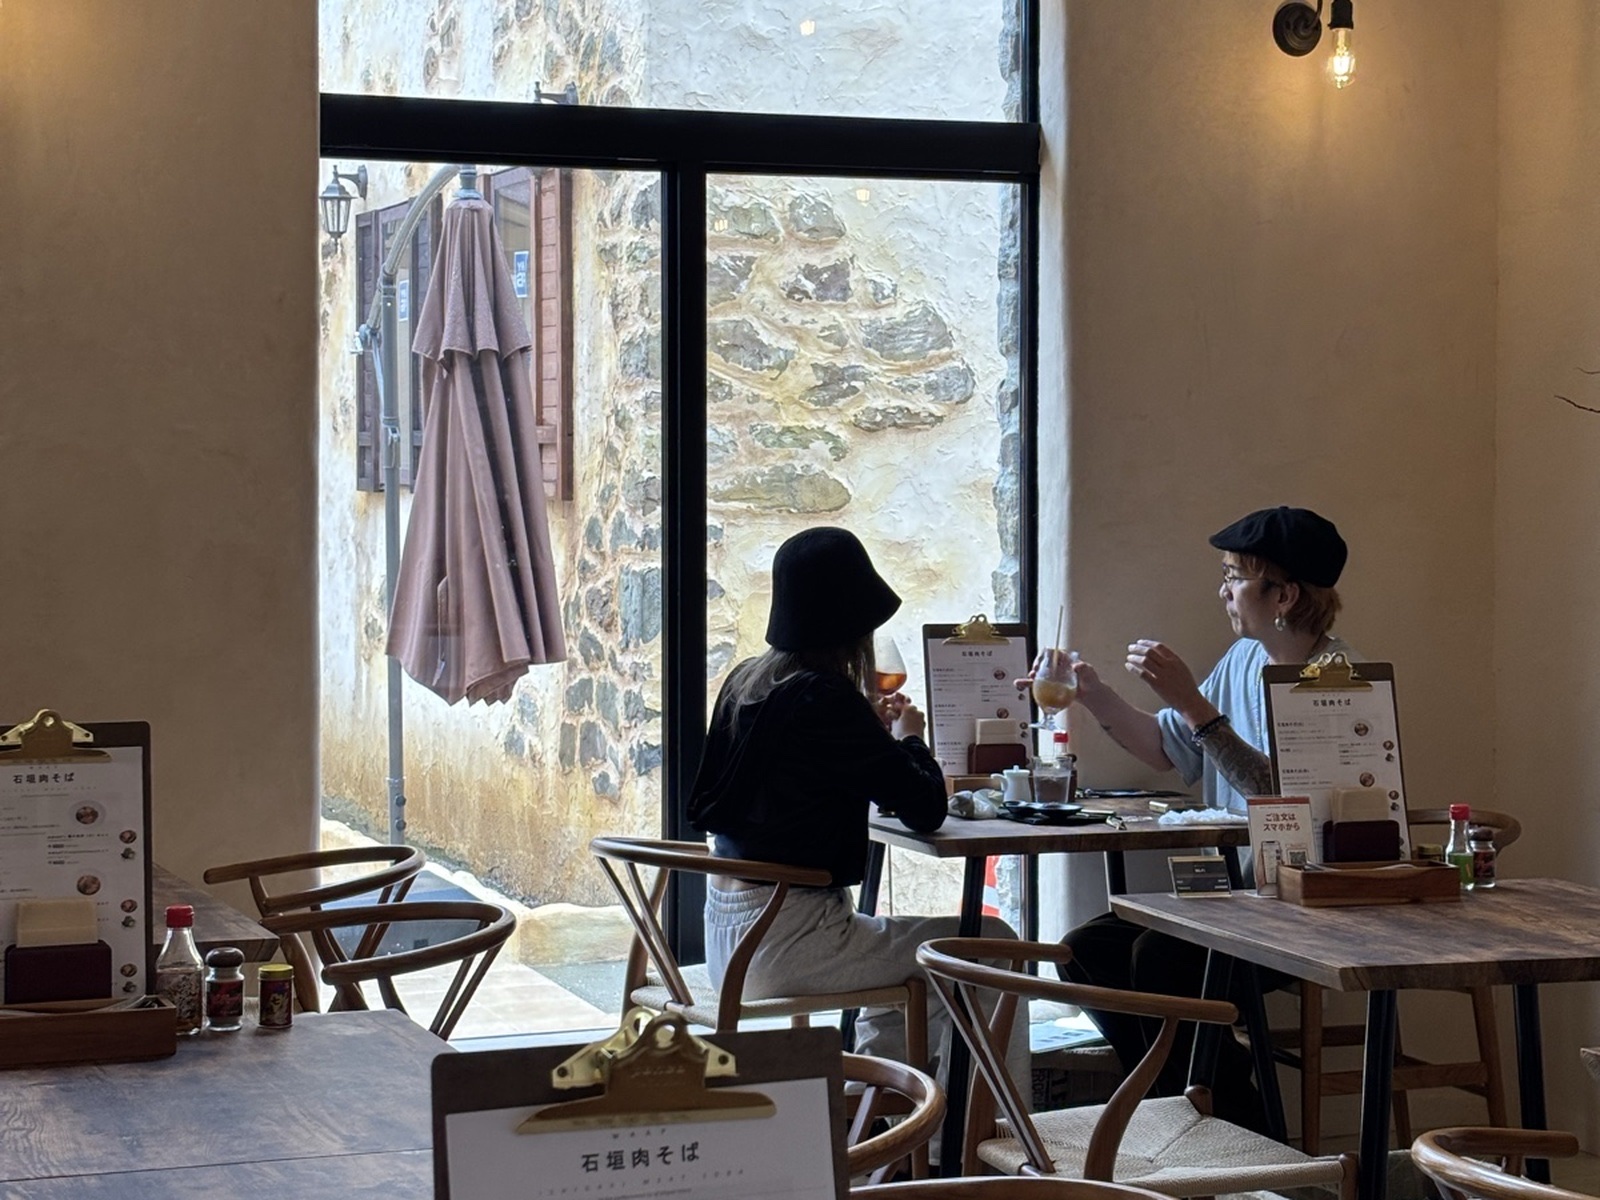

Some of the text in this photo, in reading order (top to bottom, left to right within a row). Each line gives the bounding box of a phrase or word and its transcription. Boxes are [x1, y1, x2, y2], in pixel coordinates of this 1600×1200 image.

[13, 772, 75, 784] 石垣肉そば
[1265, 813, 1297, 822] ご注文は
[1263, 823, 1301, 831] スマホから
[581, 1142, 699, 1173] 石垣肉そば
